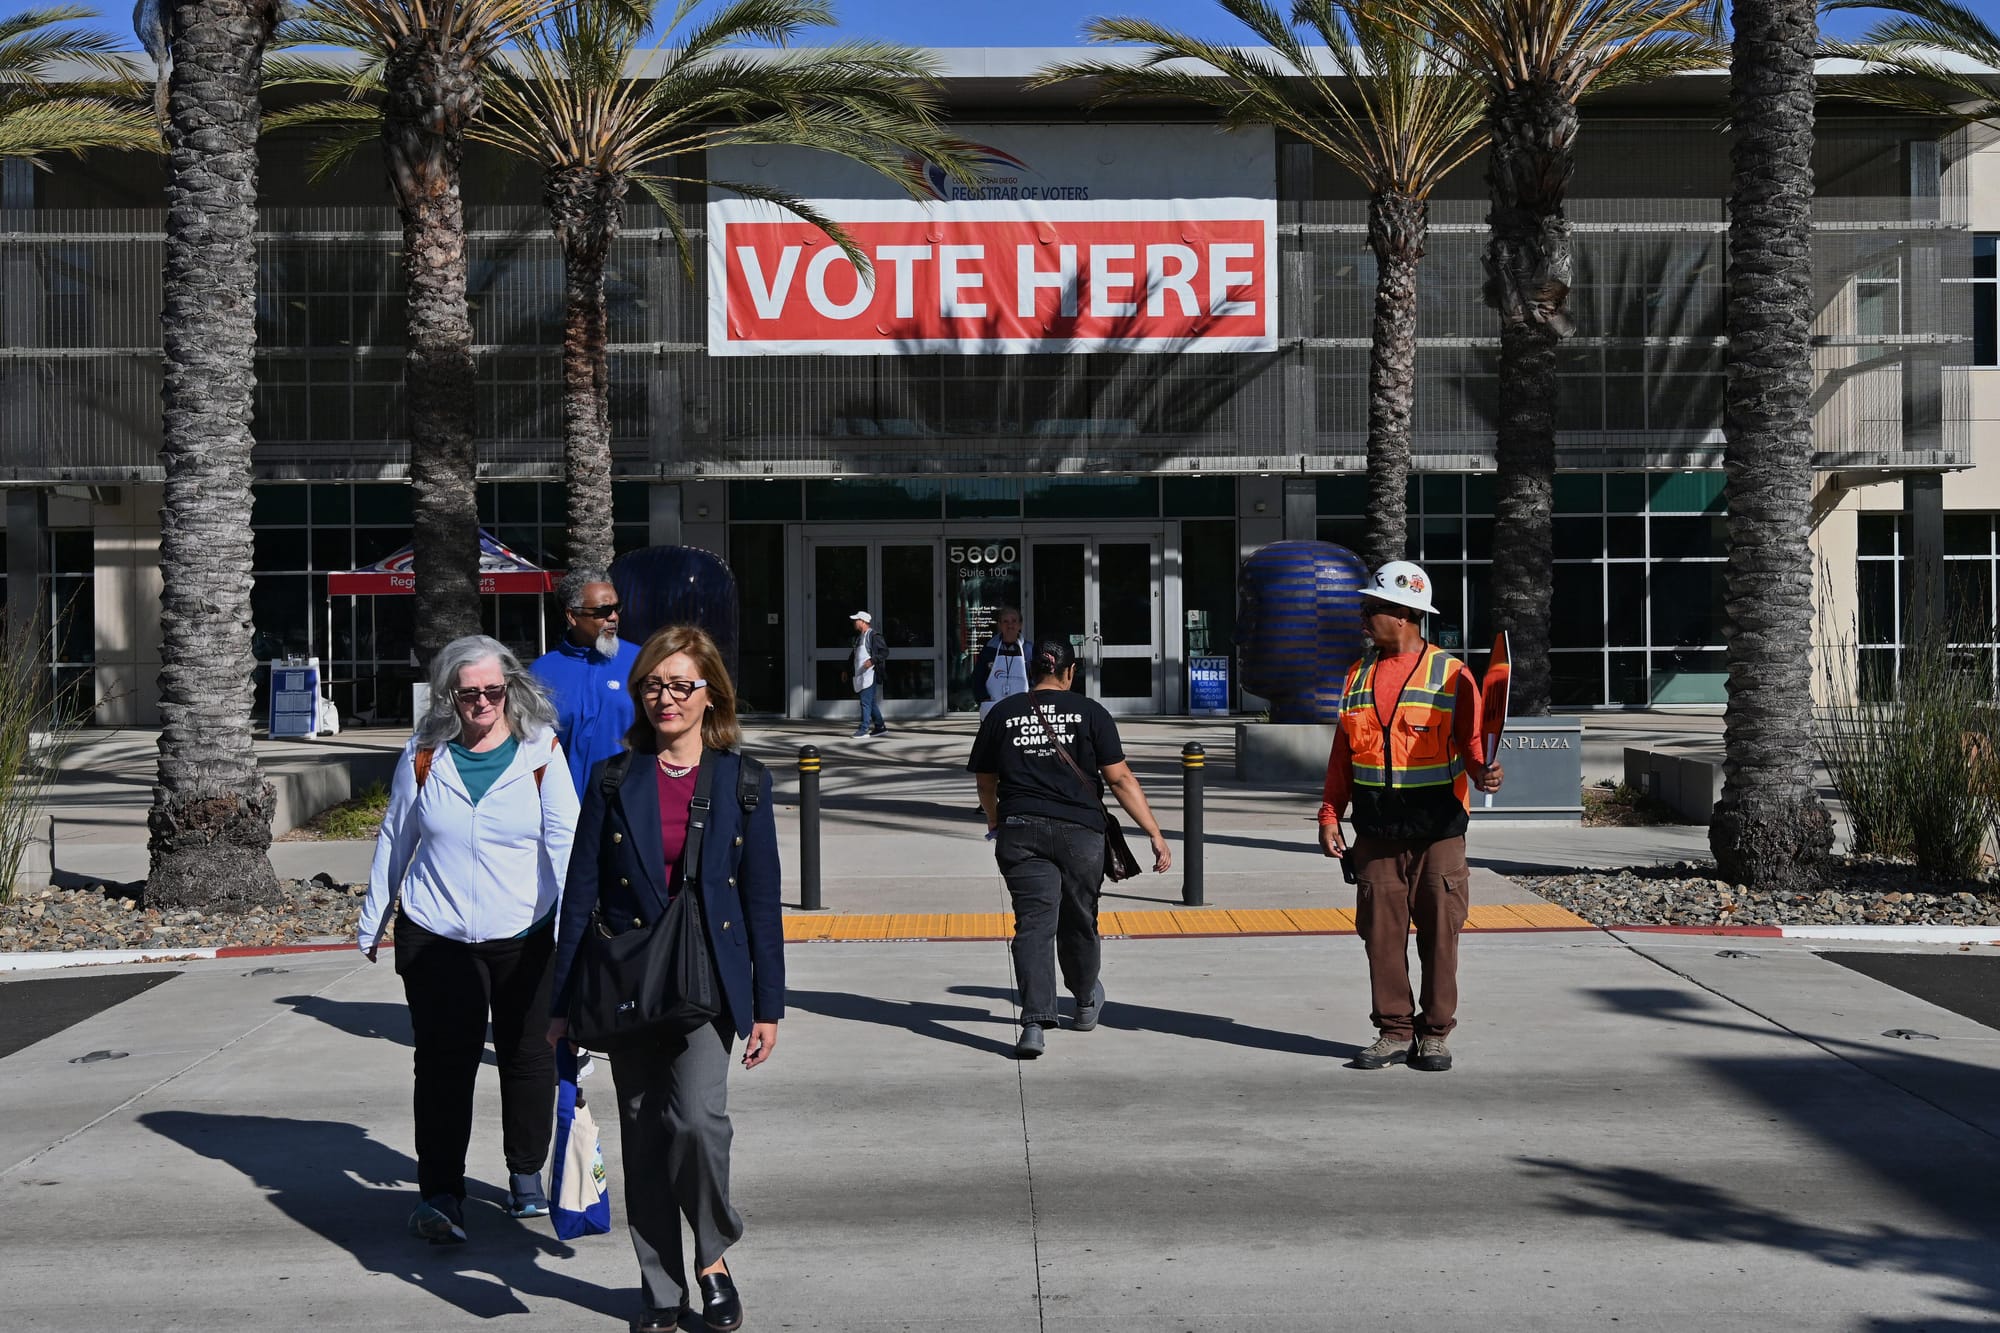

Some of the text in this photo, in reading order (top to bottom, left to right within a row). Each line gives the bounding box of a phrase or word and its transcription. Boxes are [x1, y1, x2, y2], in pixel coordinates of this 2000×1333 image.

[999, 177, 1018, 185] DIEGO
[952, 186, 1089, 200] REGISTRAR OF VOTERS
[736, 243, 1256, 320] VOTE HERE
[950, 546, 1016, 564] 5600
[959, 567, 1008, 578] Suite 100
[1191, 659, 1226, 669] VOTE
[1191, 670, 1226, 681] HERE
[1005, 713, 1082, 728] STARUCKS
[1020, 724, 1066, 735] COFEE
[1013, 734, 1075, 746] COMPNY
[1518, 736, 1570, 749] PLAZA
